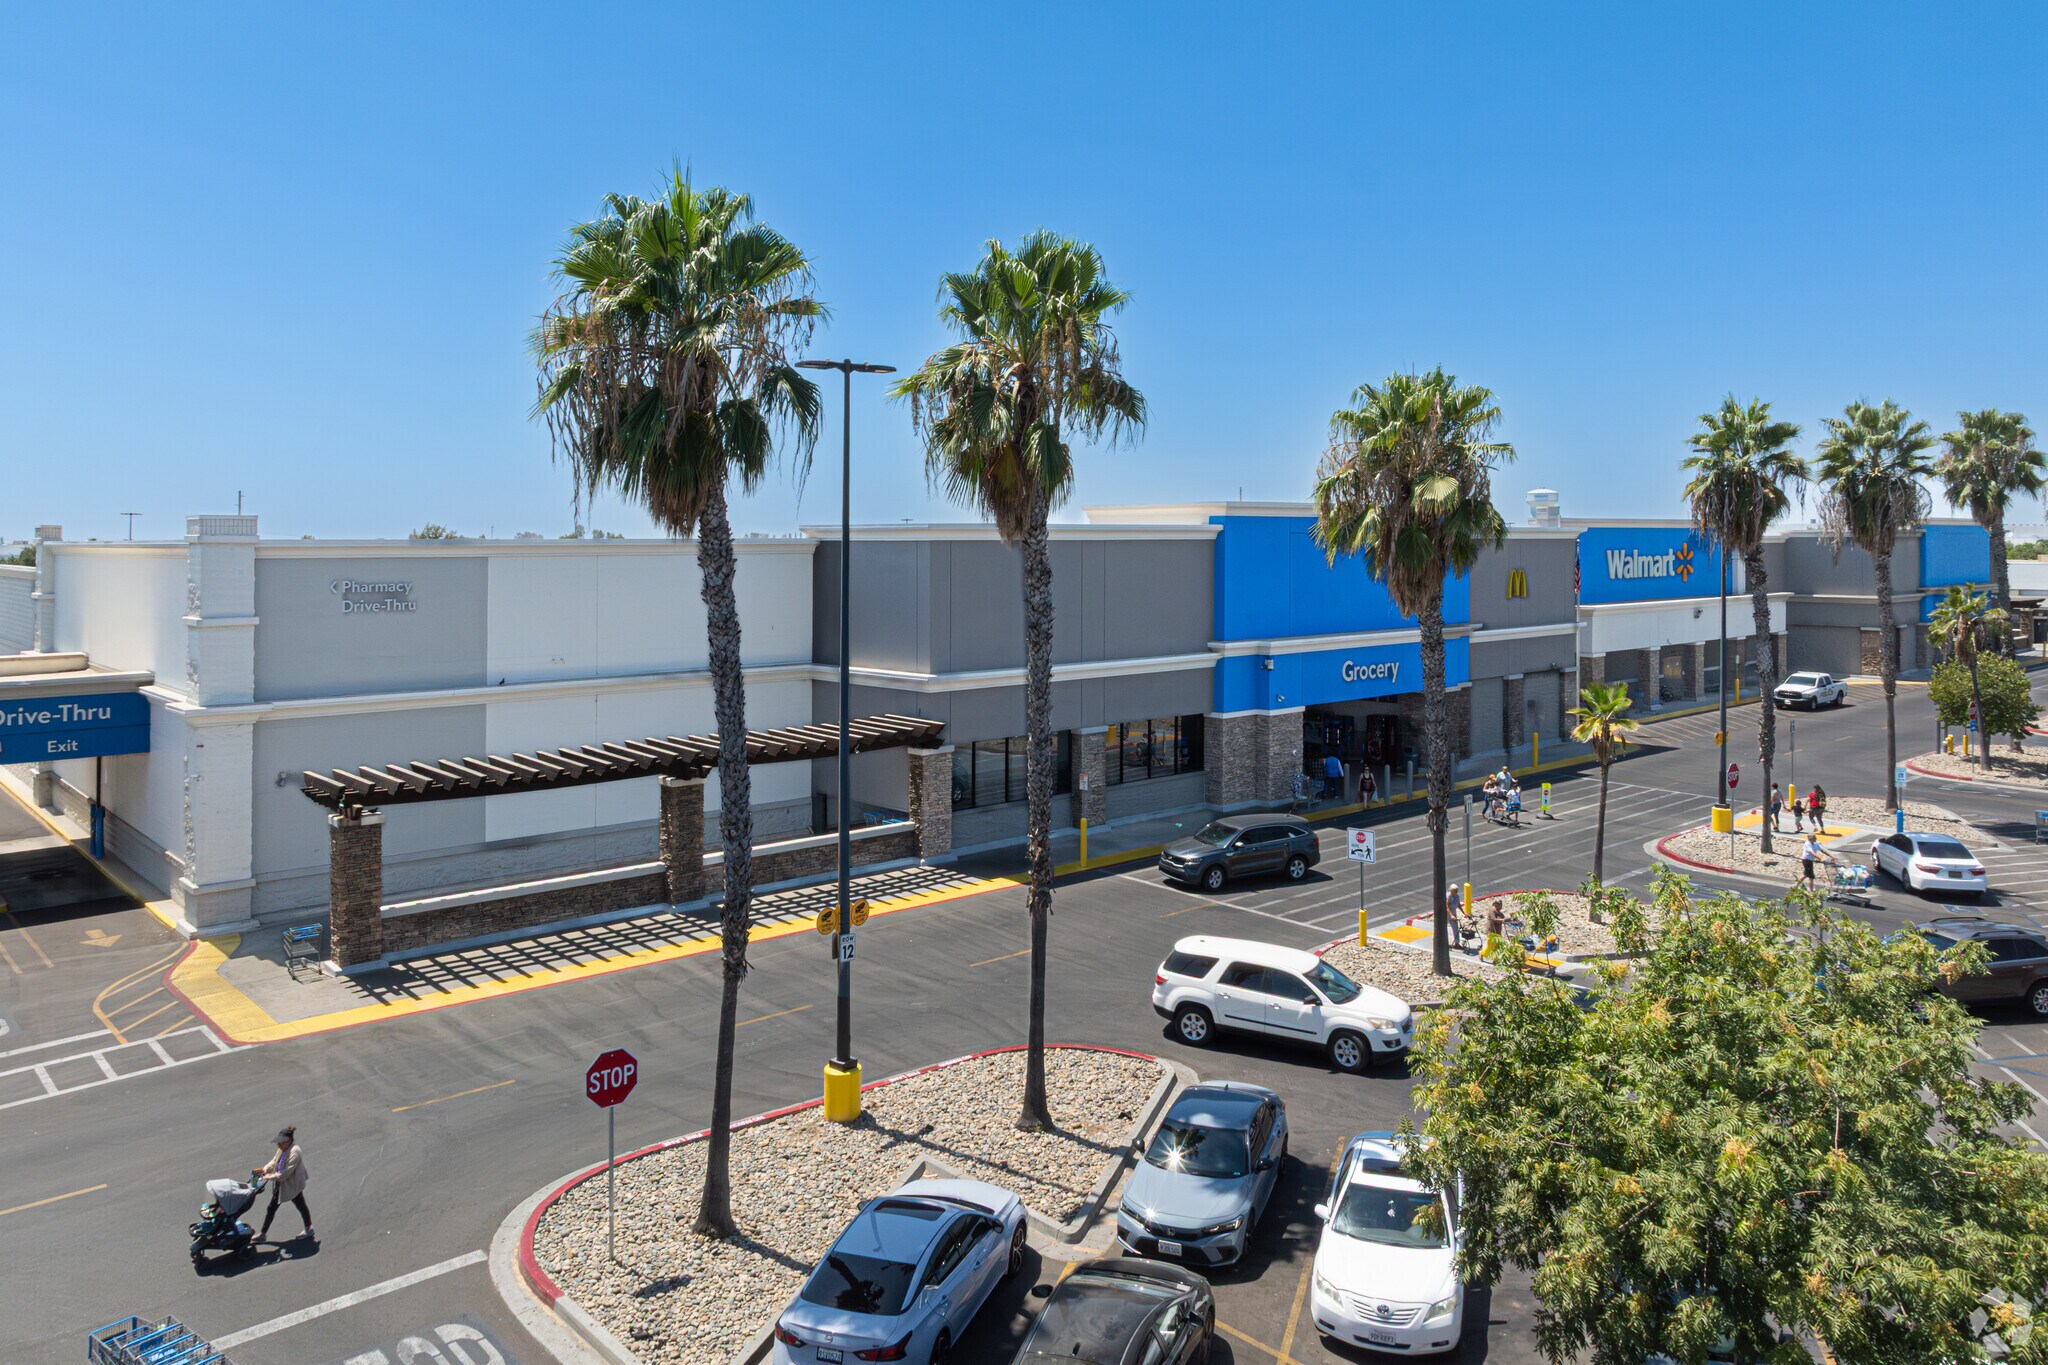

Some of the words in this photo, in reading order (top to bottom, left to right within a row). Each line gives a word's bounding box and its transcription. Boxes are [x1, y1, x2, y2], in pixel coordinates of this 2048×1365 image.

[1606, 548, 1676, 579] Walmart
[342, 580, 412, 595] Pharmacy
[342, 599, 416, 613] Drive-Thru
[1342, 660, 1399, 683] Grocery
[47, 740, 78, 753] Exit
[842, 935, 854, 943] ROW
[842, 944, 854, 959] 12
[589, 1063, 635, 1094] STOP
